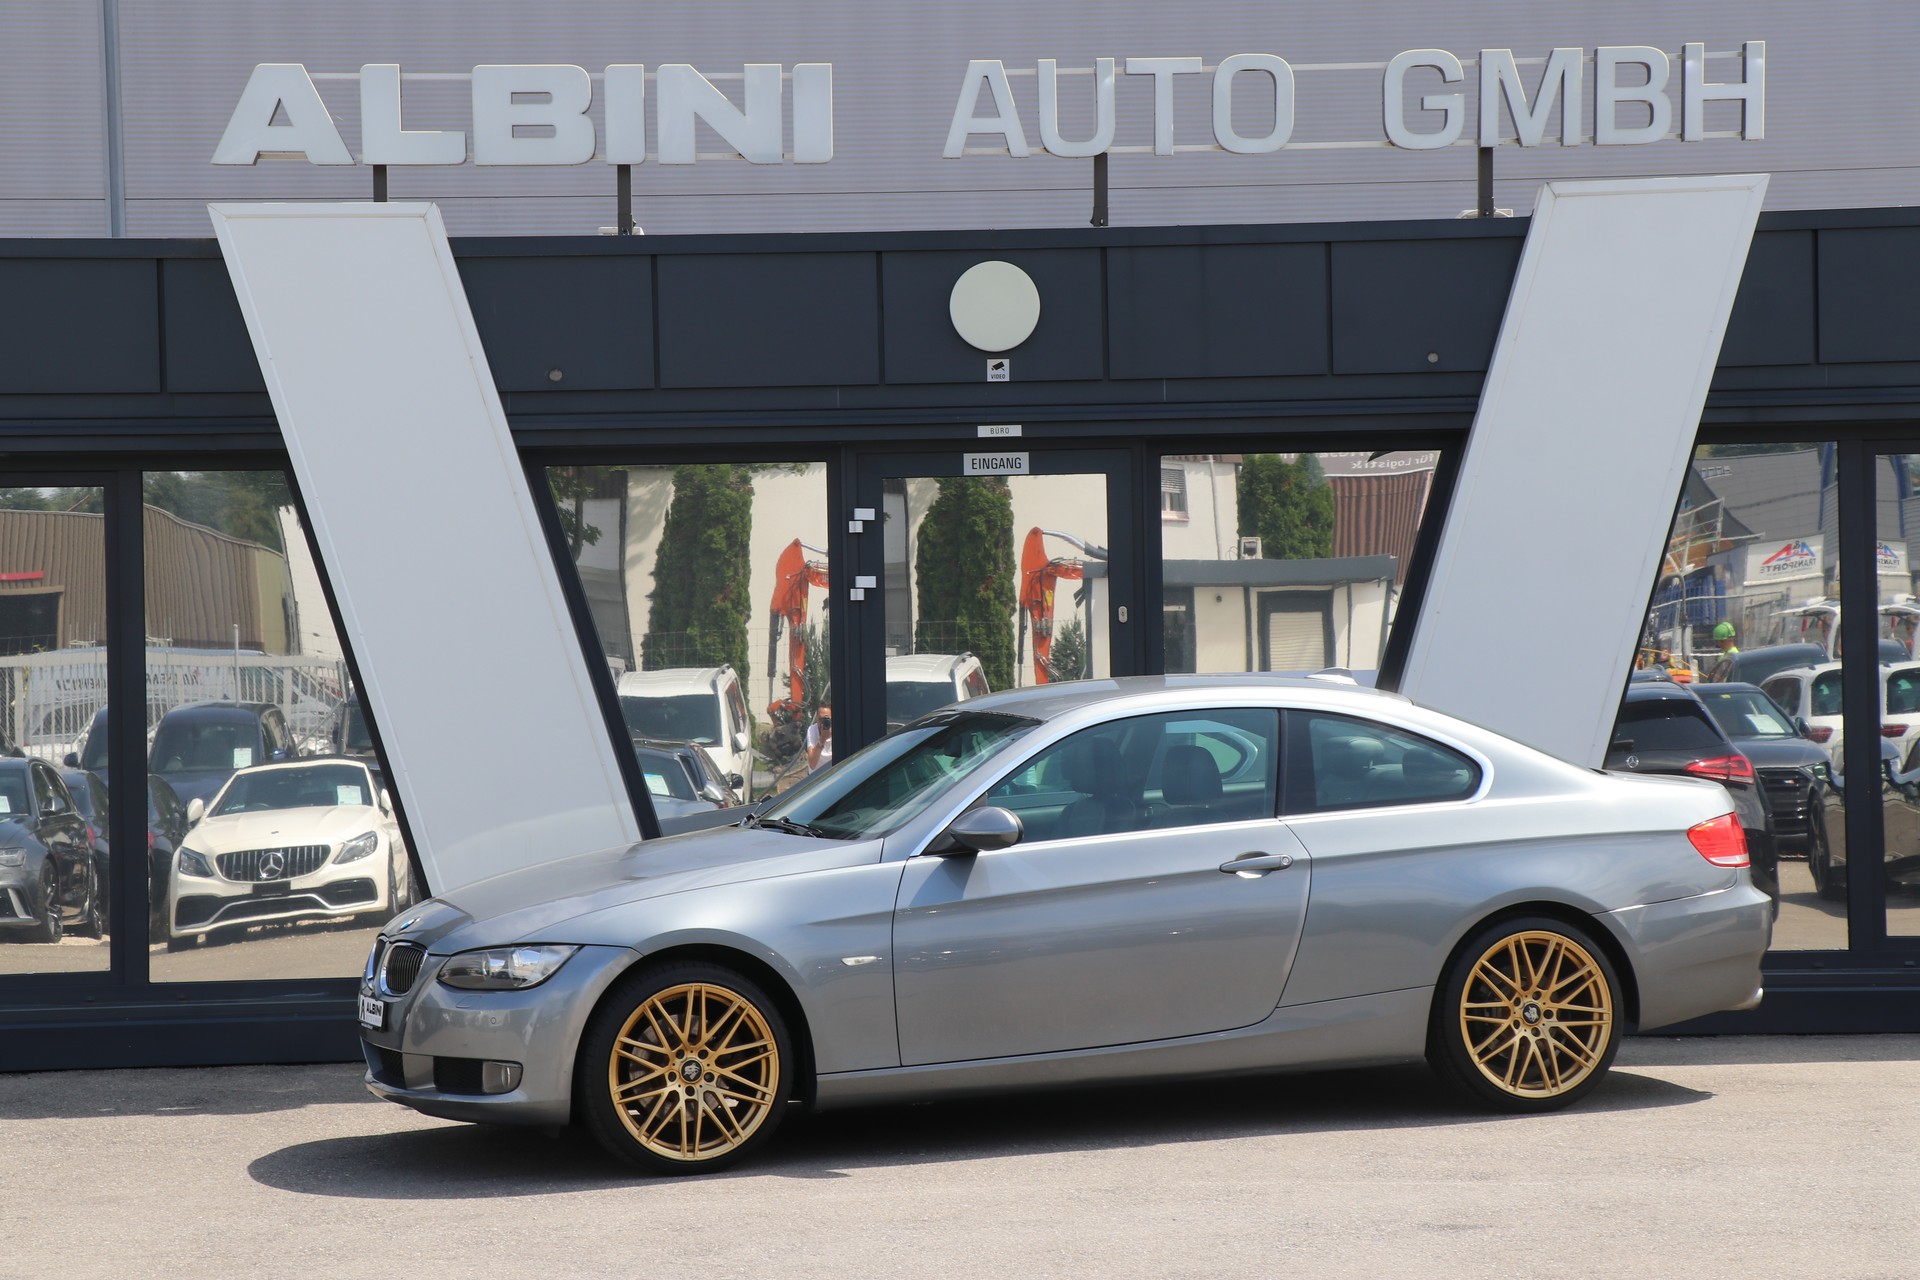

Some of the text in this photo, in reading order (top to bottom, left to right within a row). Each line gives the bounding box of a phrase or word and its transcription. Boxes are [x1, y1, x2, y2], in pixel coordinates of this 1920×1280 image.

[210, 40, 1766, 166] ALBINI AUTO GMBH
[990, 426, 1010, 435] BÜRO
[971, 457, 1022, 470] EINGANG
